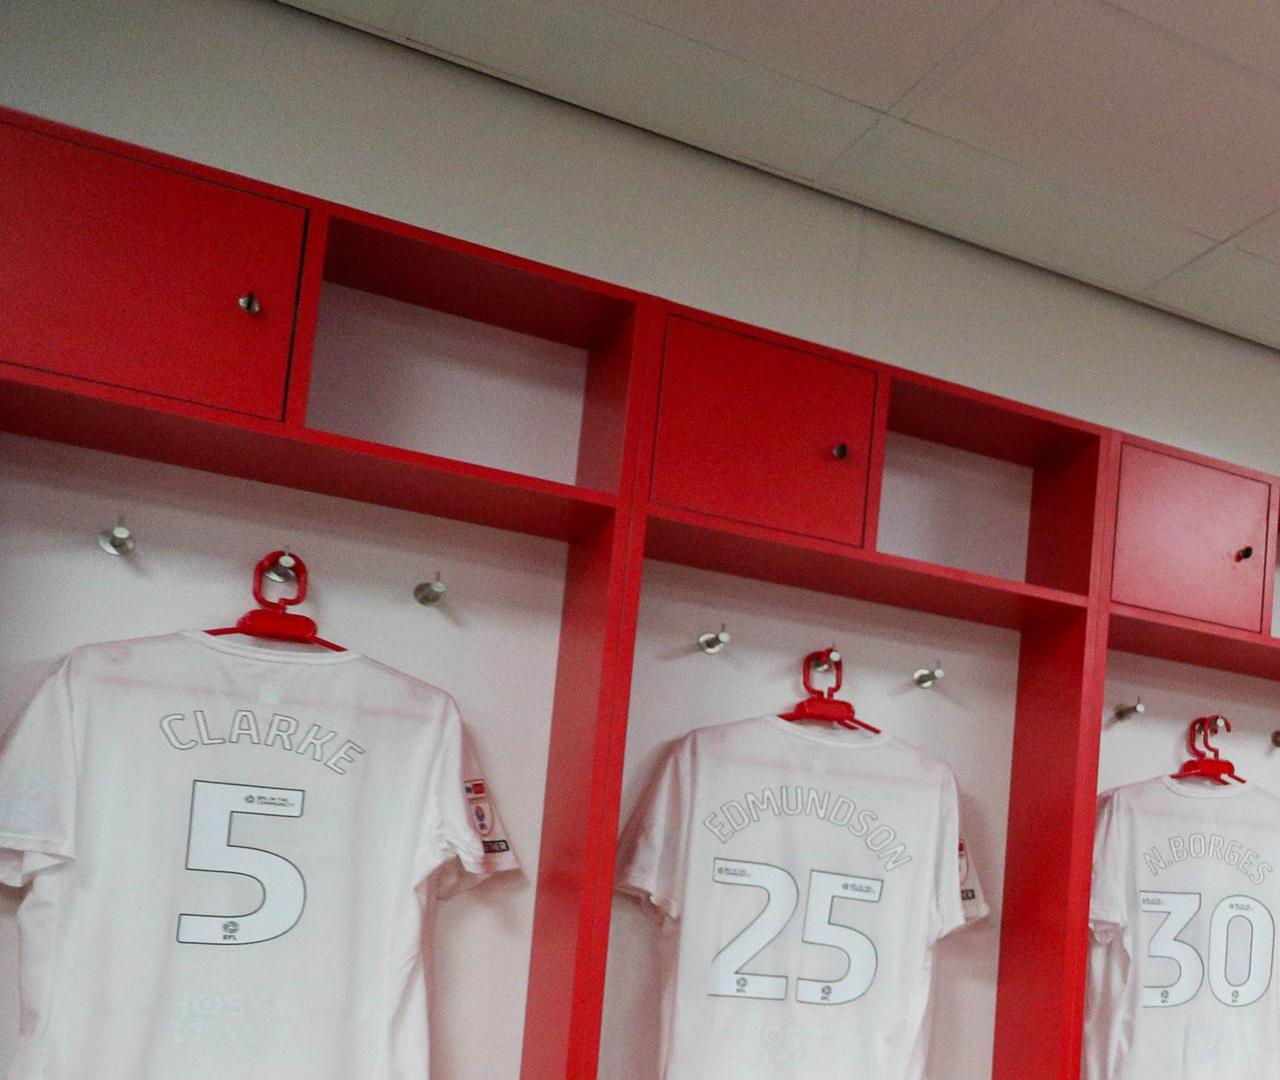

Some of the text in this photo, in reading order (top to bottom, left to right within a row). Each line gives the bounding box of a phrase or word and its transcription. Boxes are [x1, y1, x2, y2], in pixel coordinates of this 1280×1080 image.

[160, 709, 366, 776] CLARKE
[177, 780, 307, 946] 5
[702, 785, 913, 872] EDMUNDSON
[1143, 832, 1274, 885] N.BORGES
[706, 857, 884, 1006] 25
[1139, 889, 1275, 1009] 30
